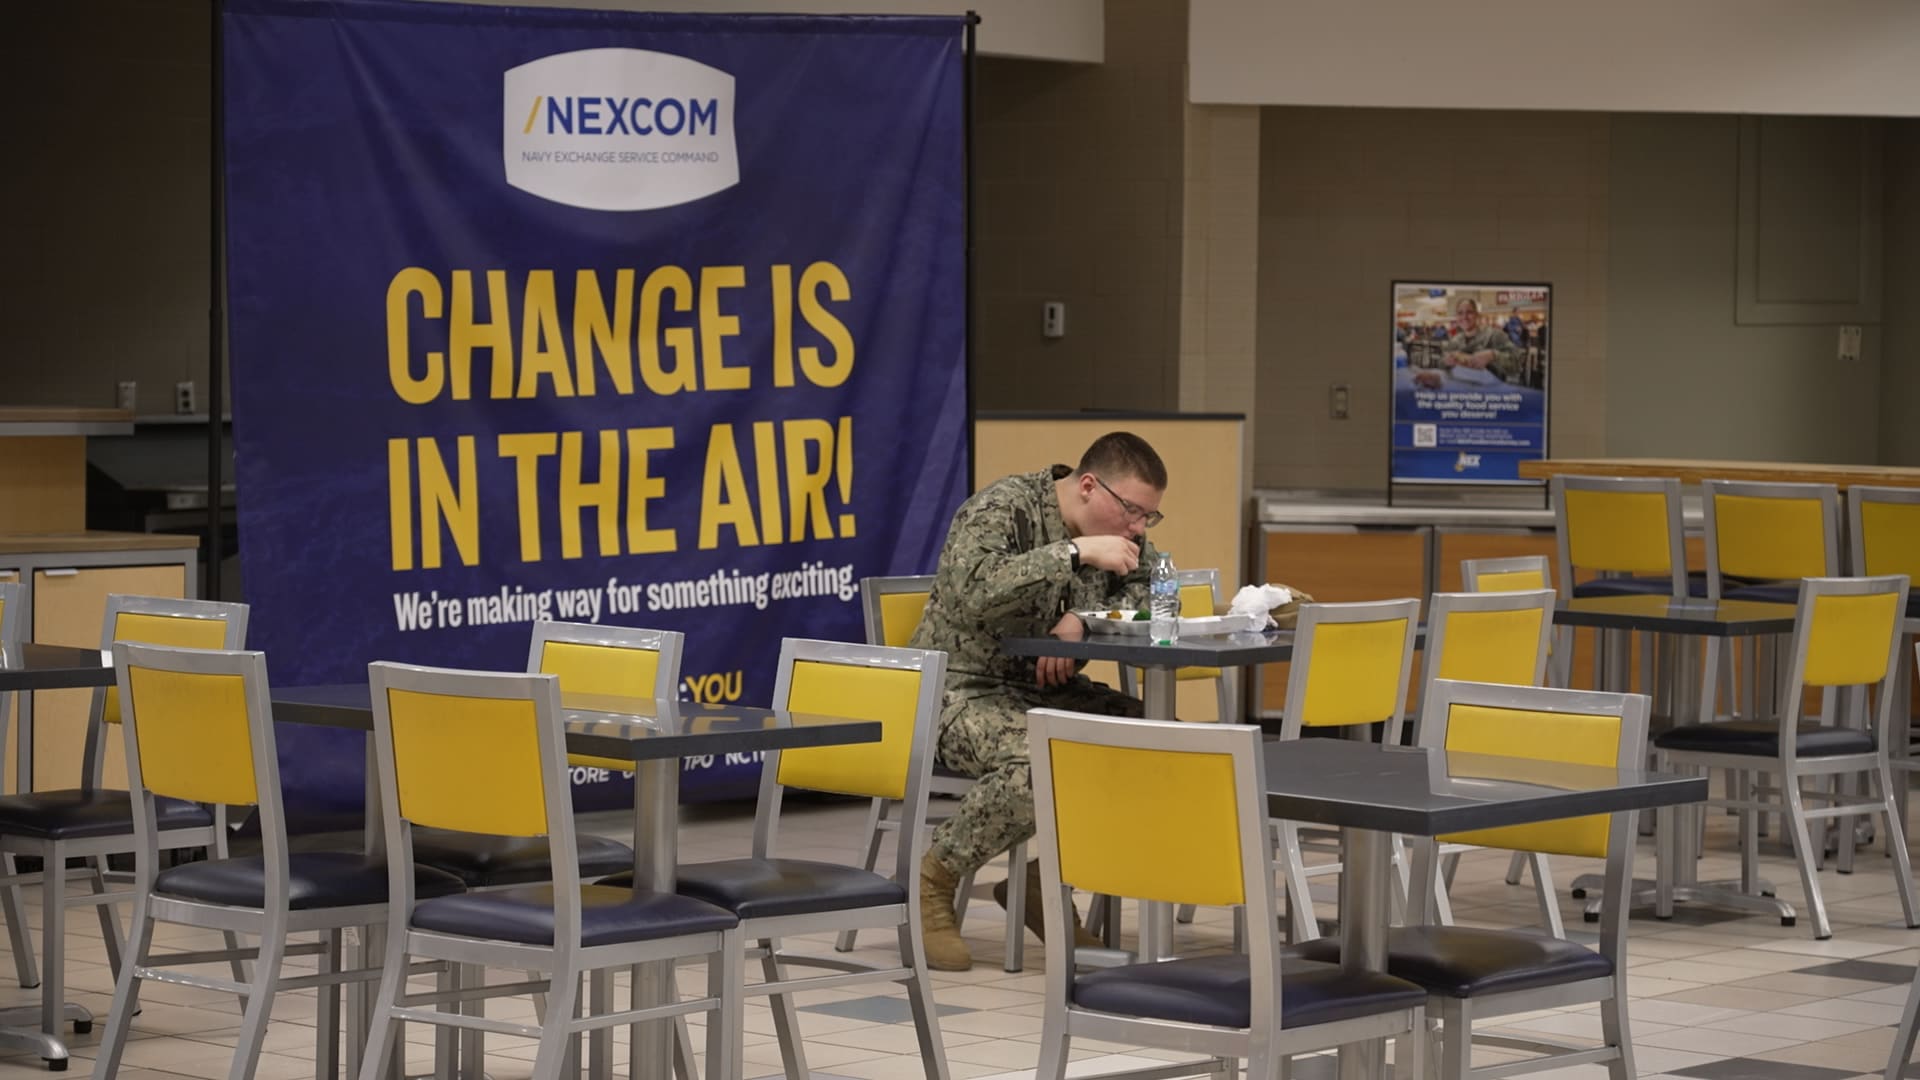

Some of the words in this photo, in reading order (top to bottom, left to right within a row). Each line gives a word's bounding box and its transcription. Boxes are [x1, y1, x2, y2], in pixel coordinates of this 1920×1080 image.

[522, 151, 551, 162] NAVY
[554, 151, 615, 163] EXCHANGE
[618, 152, 659, 164] SERVICE
[661, 152, 719, 163] COMMAND
[386, 265, 751, 404] CHANGE
[770, 261, 855, 388] IS
[388, 435, 480, 571] IN
[498, 426, 677, 562] THE
[698, 416, 856, 550] AIR!
[393, 590, 462, 631] We’re
[467, 585, 553, 624] making
[556, 587, 602, 623] way
[606, 577, 642, 614] for
[647, 569, 770, 610] something
[771, 560, 859, 602] exciting.
